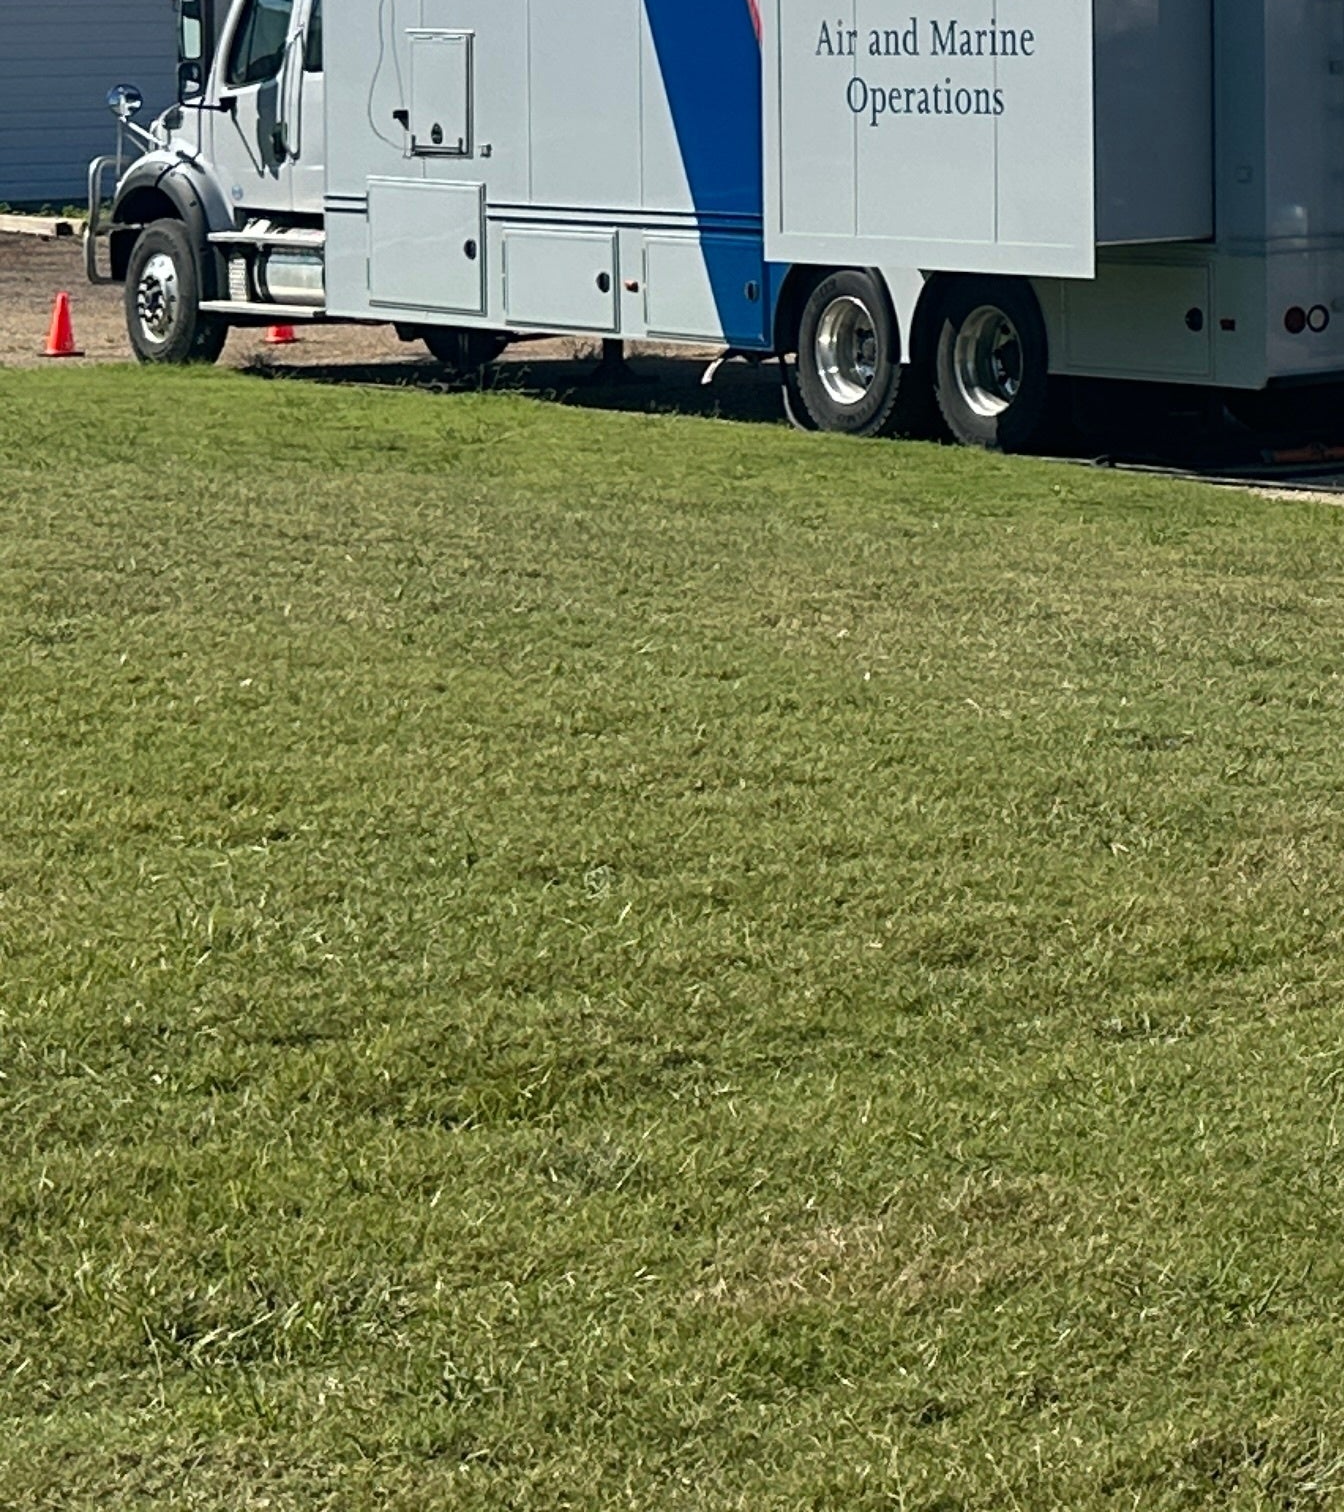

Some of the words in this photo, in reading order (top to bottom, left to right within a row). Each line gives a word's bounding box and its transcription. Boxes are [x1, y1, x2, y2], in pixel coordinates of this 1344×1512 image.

[815, 19, 857, 56] Air
[868, 17, 919, 56] and
[930, 19, 1035, 56] Marine
[846, 76, 1005, 127] Operations
